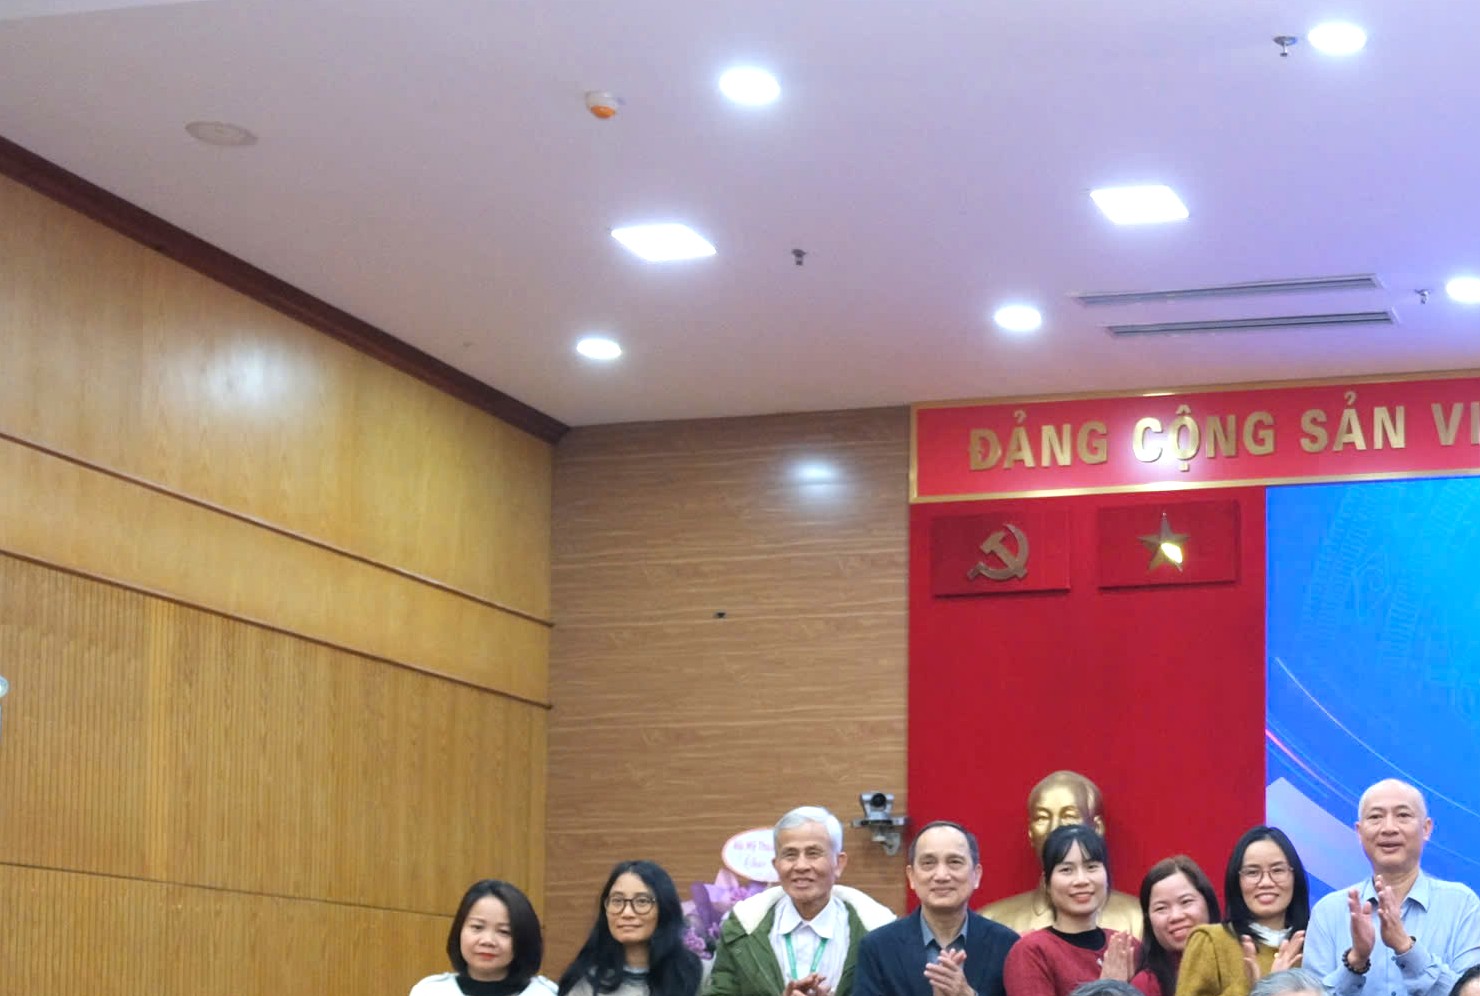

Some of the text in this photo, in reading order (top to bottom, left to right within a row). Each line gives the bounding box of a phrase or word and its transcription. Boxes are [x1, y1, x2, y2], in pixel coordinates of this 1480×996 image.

[968, 410, 1108, 471] ĐẢNG
[1132, 404, 1275, 472] CỘNG
[1300, 391, 1406, 453] SẢN
